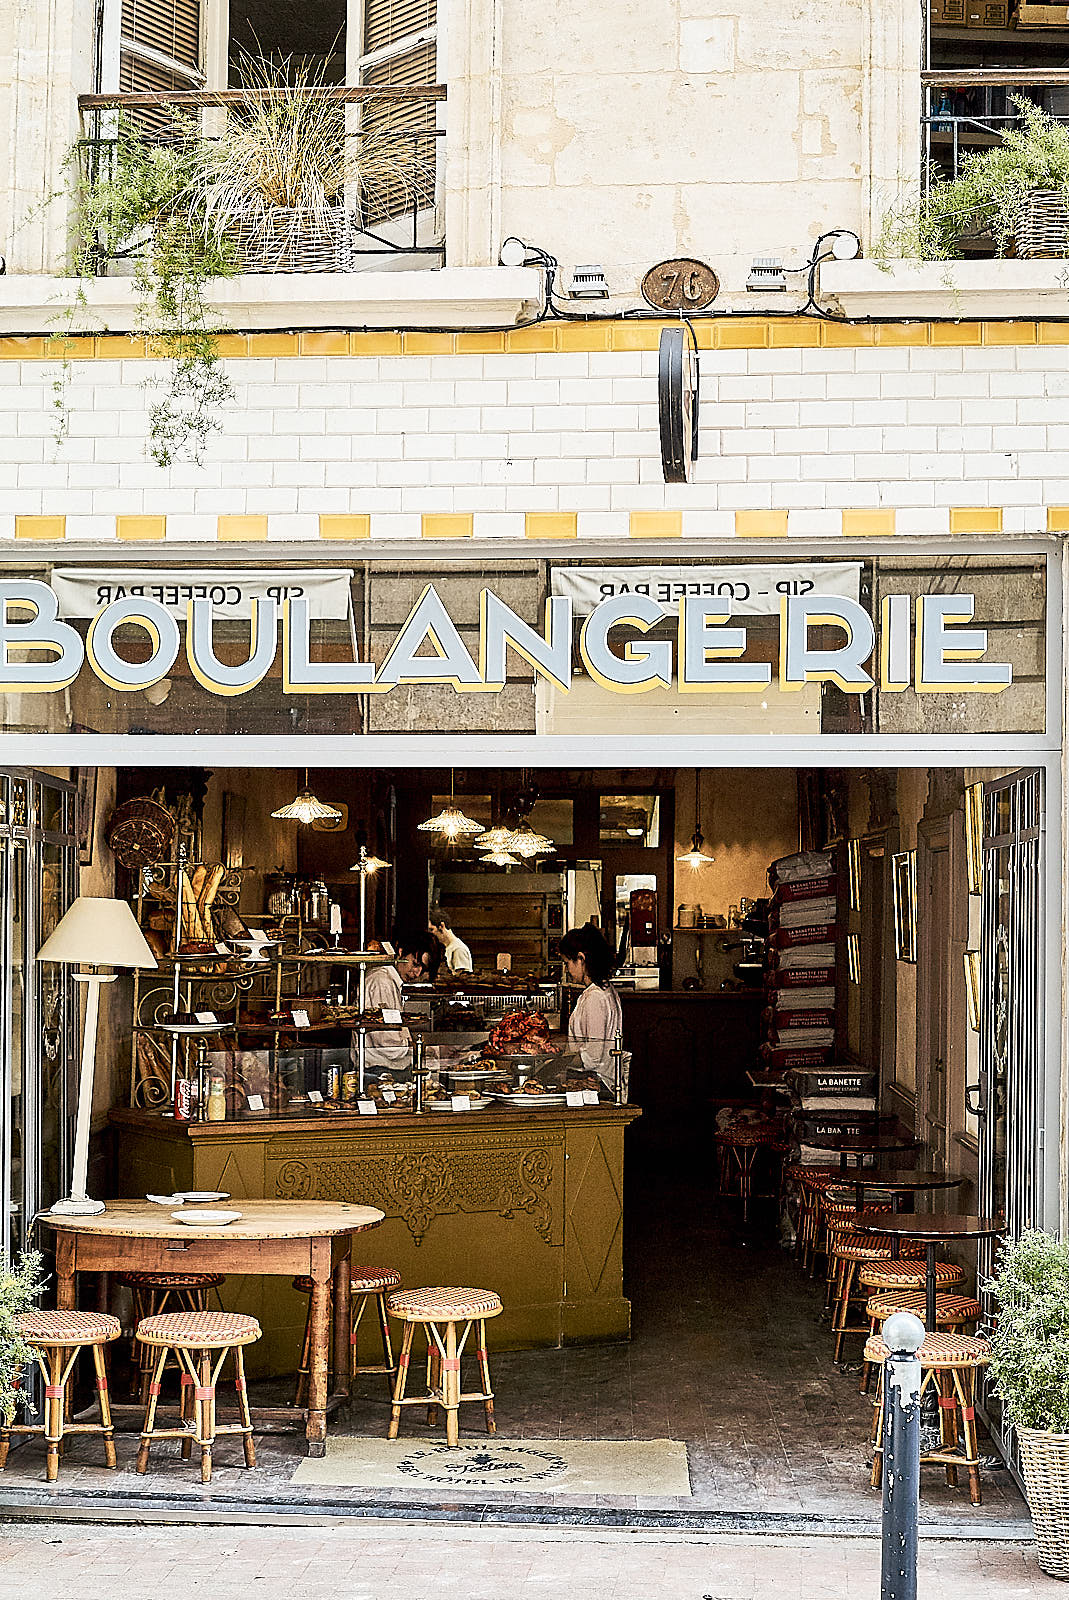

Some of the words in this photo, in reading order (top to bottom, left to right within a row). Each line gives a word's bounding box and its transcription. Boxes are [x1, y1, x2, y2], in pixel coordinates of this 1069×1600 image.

[660, 271, 702, 303] 76
[0, 578, 1013, 697] BOULANGERIE
[817, 1078, 827, 1086] LA
[828, 1078, 861, 1086] BANETTE
[816, 1126, 826, 1134] LA
